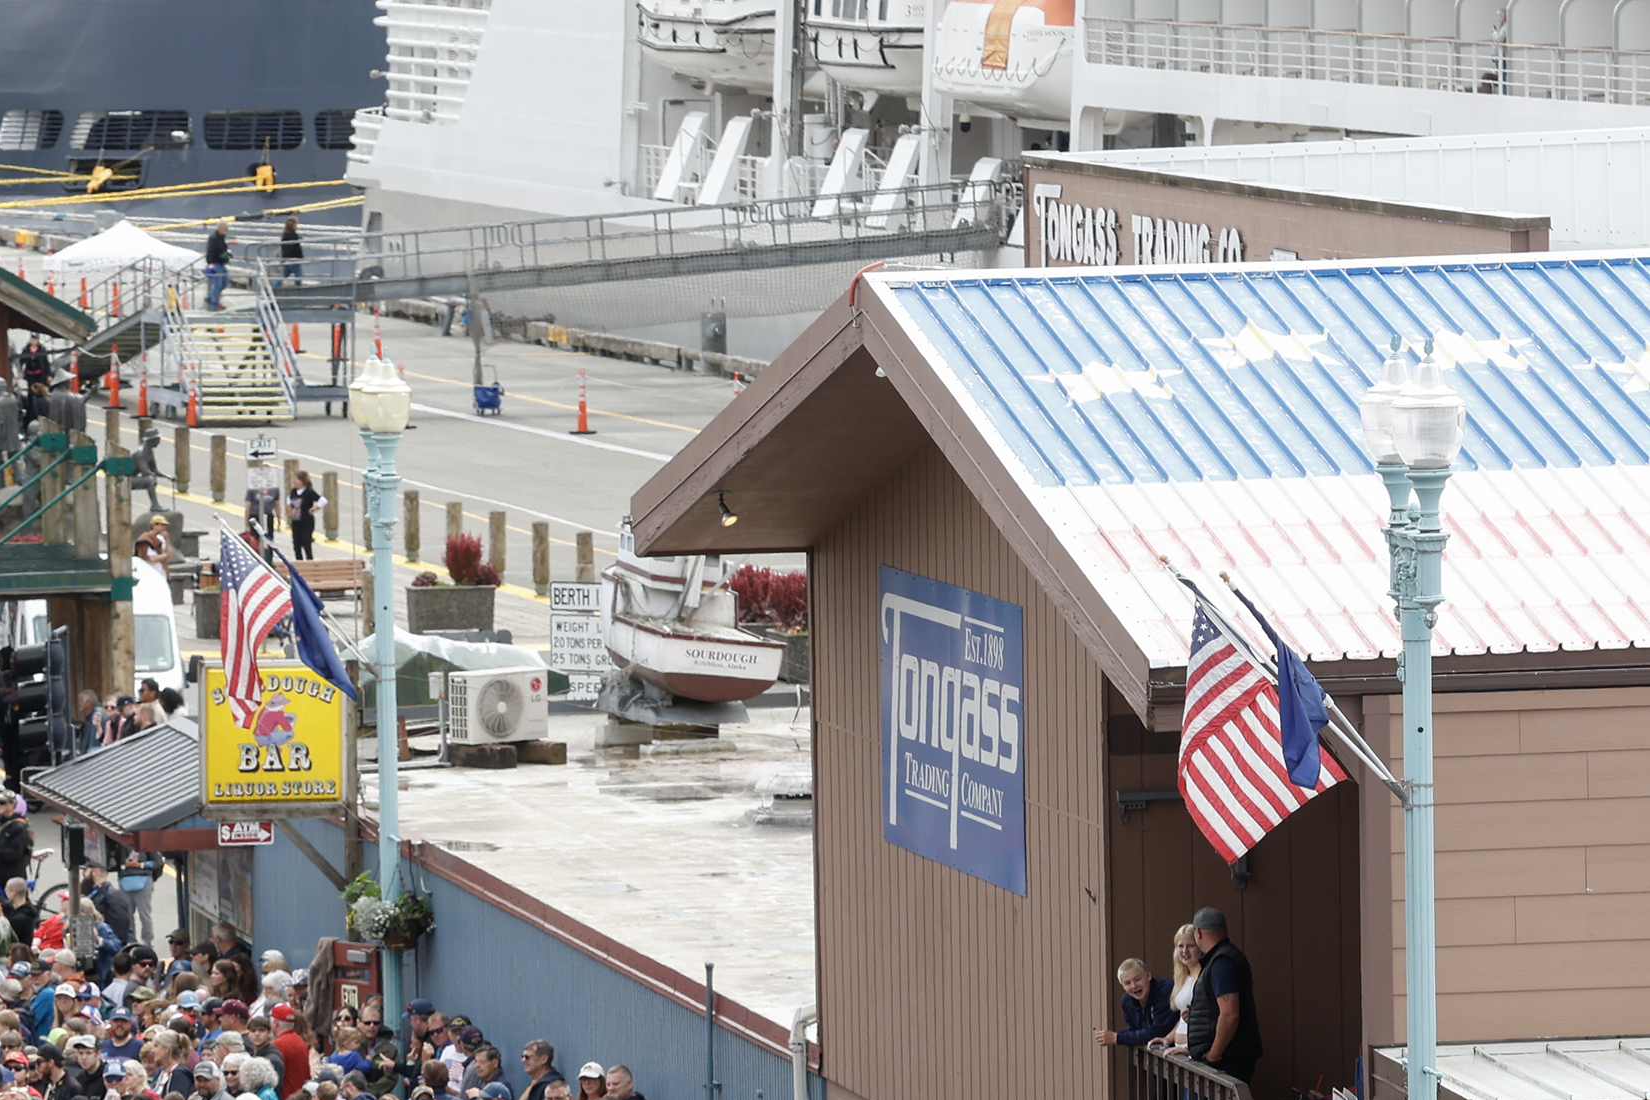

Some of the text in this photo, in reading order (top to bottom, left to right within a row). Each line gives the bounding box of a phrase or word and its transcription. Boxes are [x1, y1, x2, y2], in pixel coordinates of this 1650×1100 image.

[1034, 184, 1119, 268] TONGASS
[1131, 214, 1212, 265] TRADING
[250, 439, 271, 448] EXIT
[554, 587, 590, 606] BERTH
[556, 621, 589, 633] WEIGHT
[553, 637, 603, 649] 20 TONS PER
[553, 653, 613, 666] 25 TONS GRO
[685, 648, 758, 664] SOURDOUGH
[211, 674, 336, 705] SDOUGH
[570, 682, 602, 694] SPEE
[881, 592, 1020, 850] Tongass
[237, 742, 312, 773] BAR
[214, 780, 337, 797] LIQUOR STORE
[904, 752, 1004, 818] TRADING COMPANY
[233, 821, 260, 832] ATM
